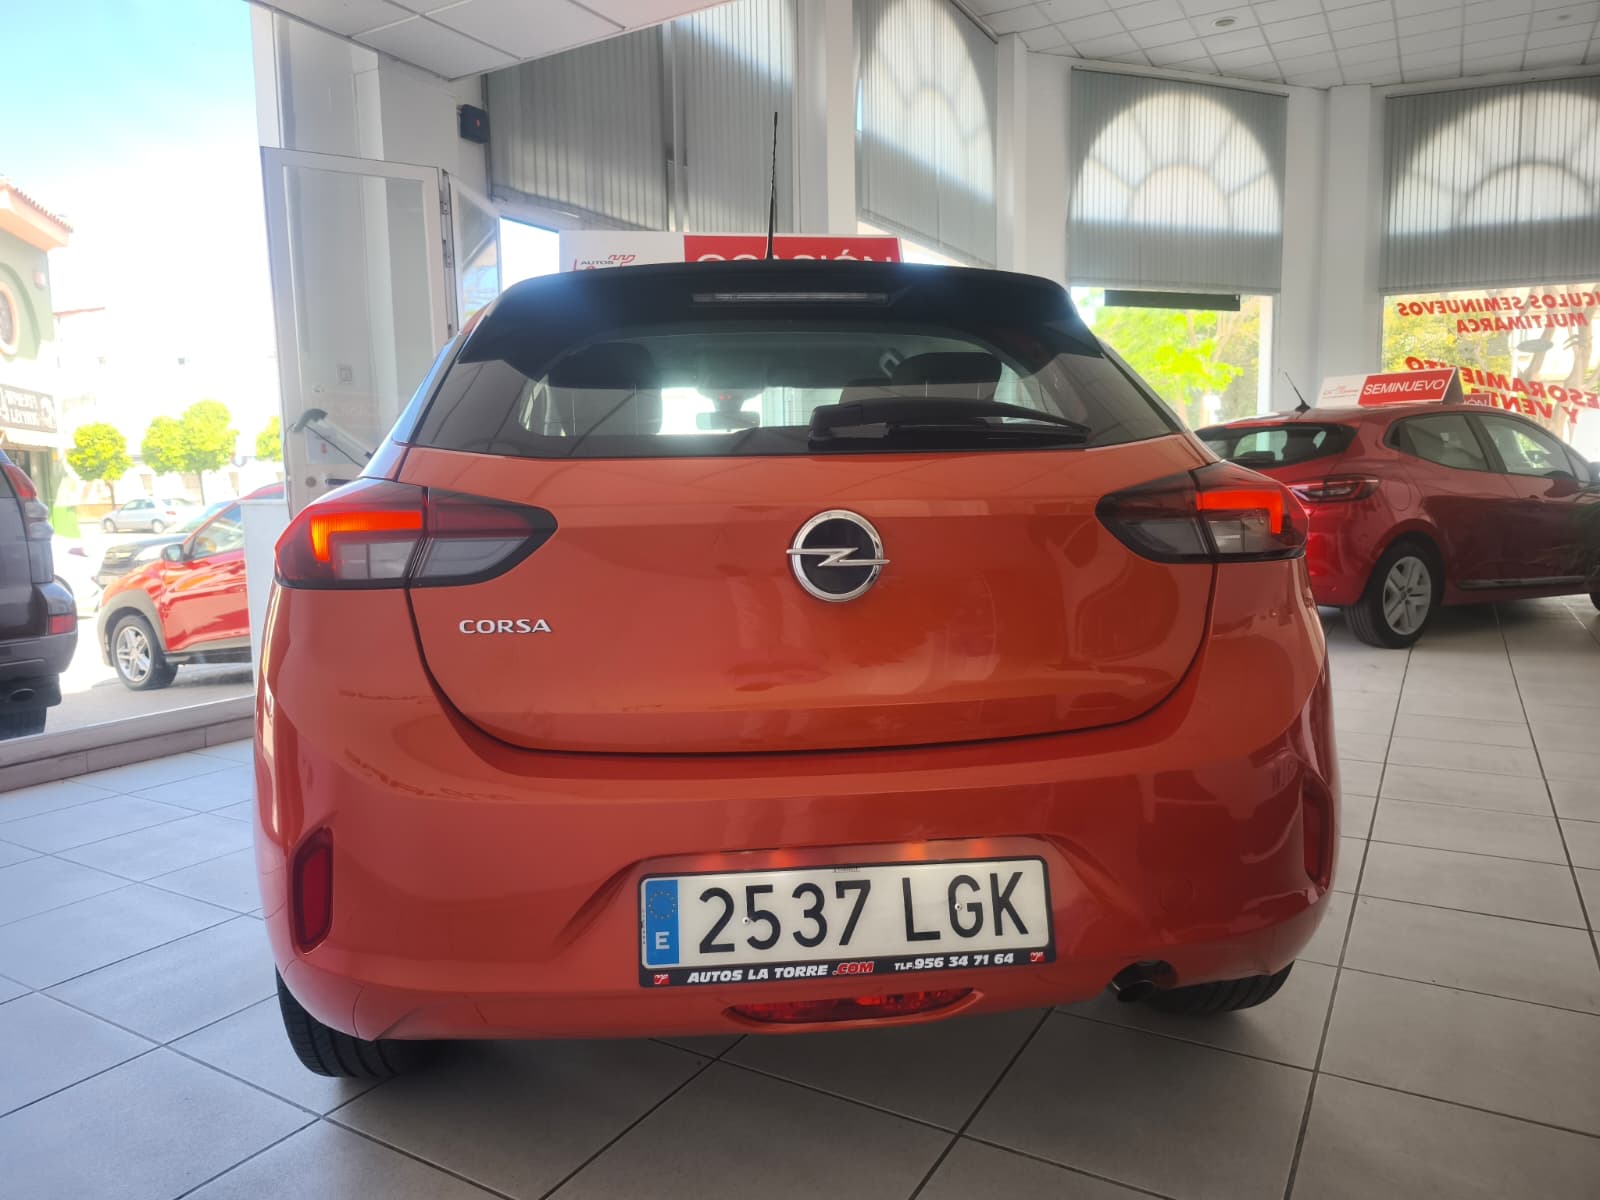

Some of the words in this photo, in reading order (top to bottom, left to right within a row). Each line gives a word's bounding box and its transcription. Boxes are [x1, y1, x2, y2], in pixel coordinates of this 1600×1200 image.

[1363, 379, 1445, 395] SEMINUEVO
[458, 618, 552, 634] CORSA
[699, 879, 871, 954] 2537
[902, 871, 1029, 942] LGK
[655, 931, 671, 950] E
[948, 955, 969, 967] 34
[973, 954, 990, 966] 71
[994, 952, 1014, 964] 64
[687, 970, 743, 983] AUTOS
[747, 968, 769, 980] LA
[774, 964, 828, 979] TORRE
[832, 961, 875, 975] .COM
